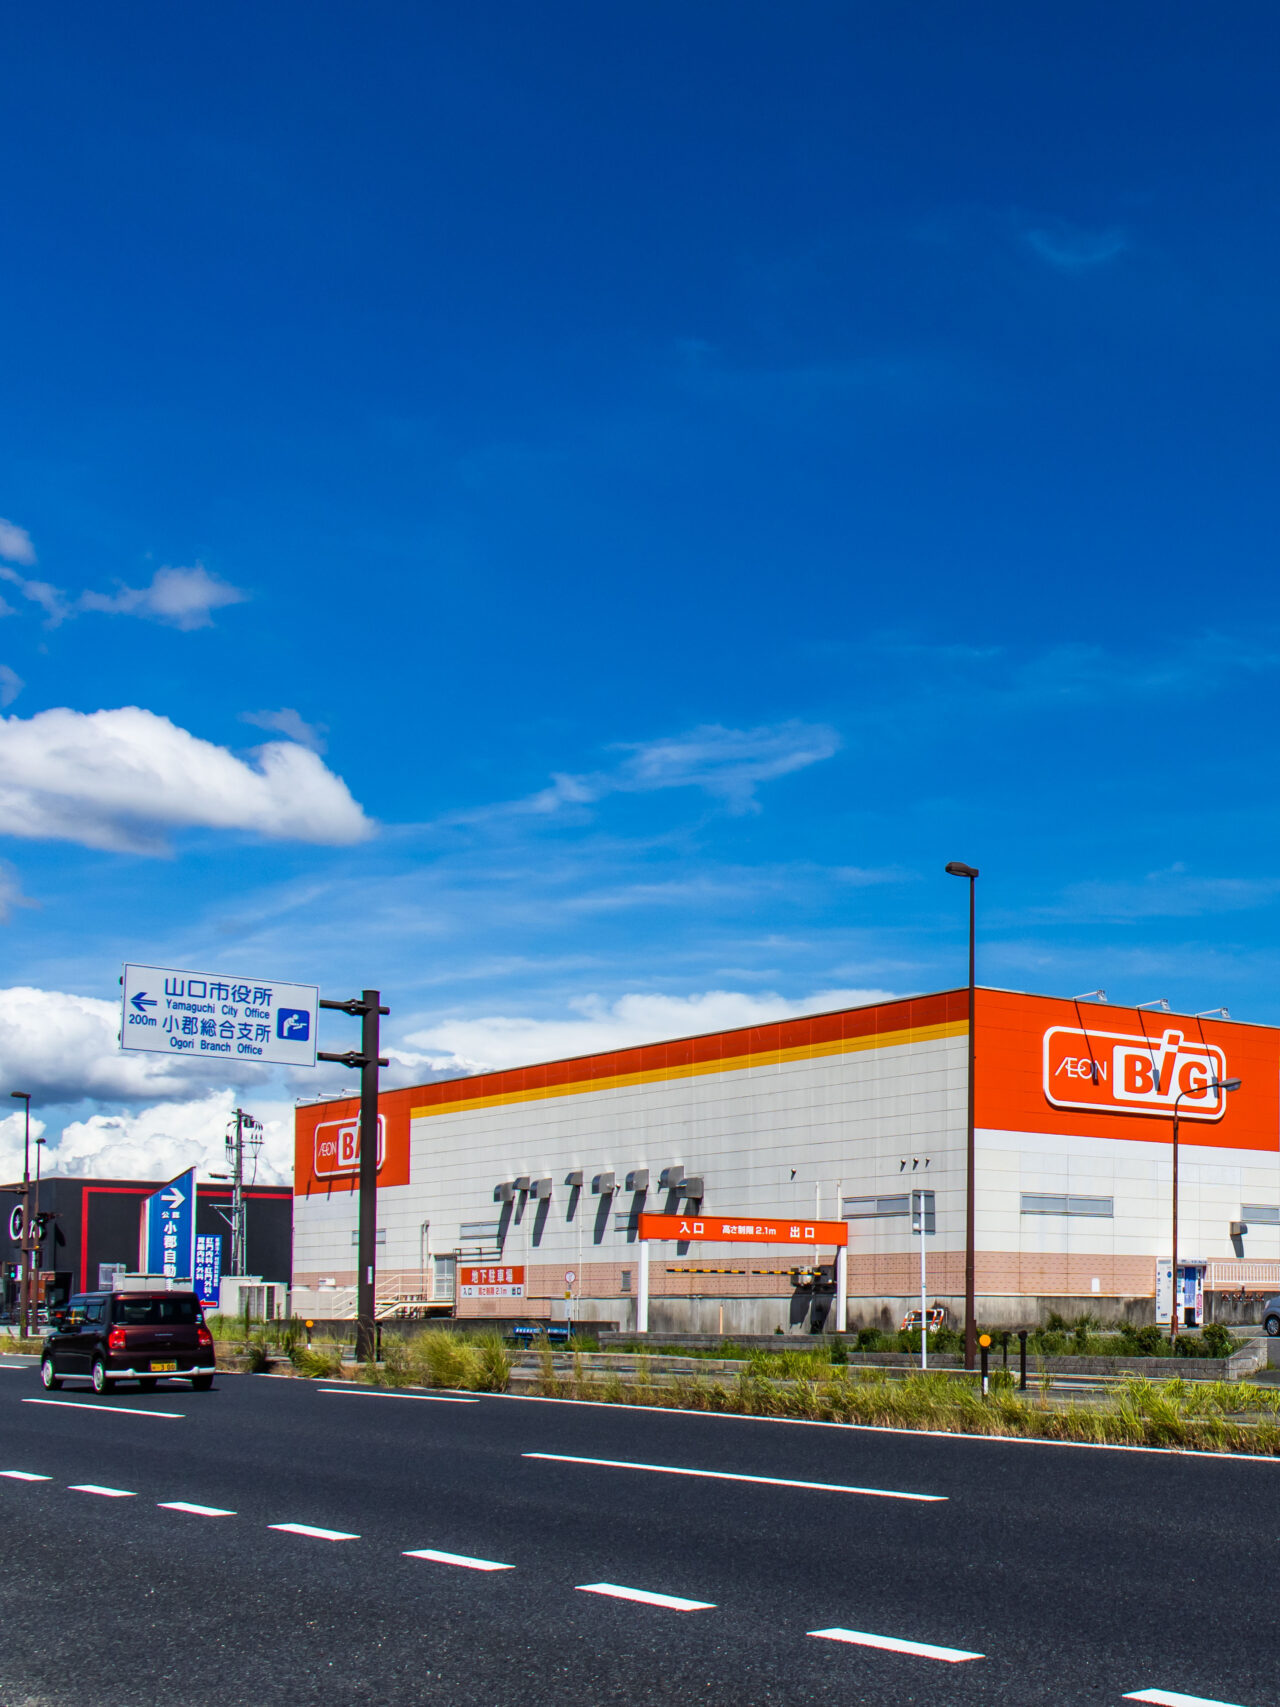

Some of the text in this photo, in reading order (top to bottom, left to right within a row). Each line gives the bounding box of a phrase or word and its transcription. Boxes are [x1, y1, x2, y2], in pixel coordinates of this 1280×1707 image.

[164, 977, 273, 1007] 山口市役所
[166, 998, 270, 1020] Yamaguchi City Office
[129, 1014, 157, 1027] 200m
[162, 1014, 271, 1044] 小郡総合支所
[170, 1037, 263, 1055] Ogori Branch Office
[680, 1221, 704, 1235] 入口
[789, 1226, 815, 1239] 出口
[471, 1268, 513, 1284] 地下駐車場
[463, 1287, 473, 1296] 入口
